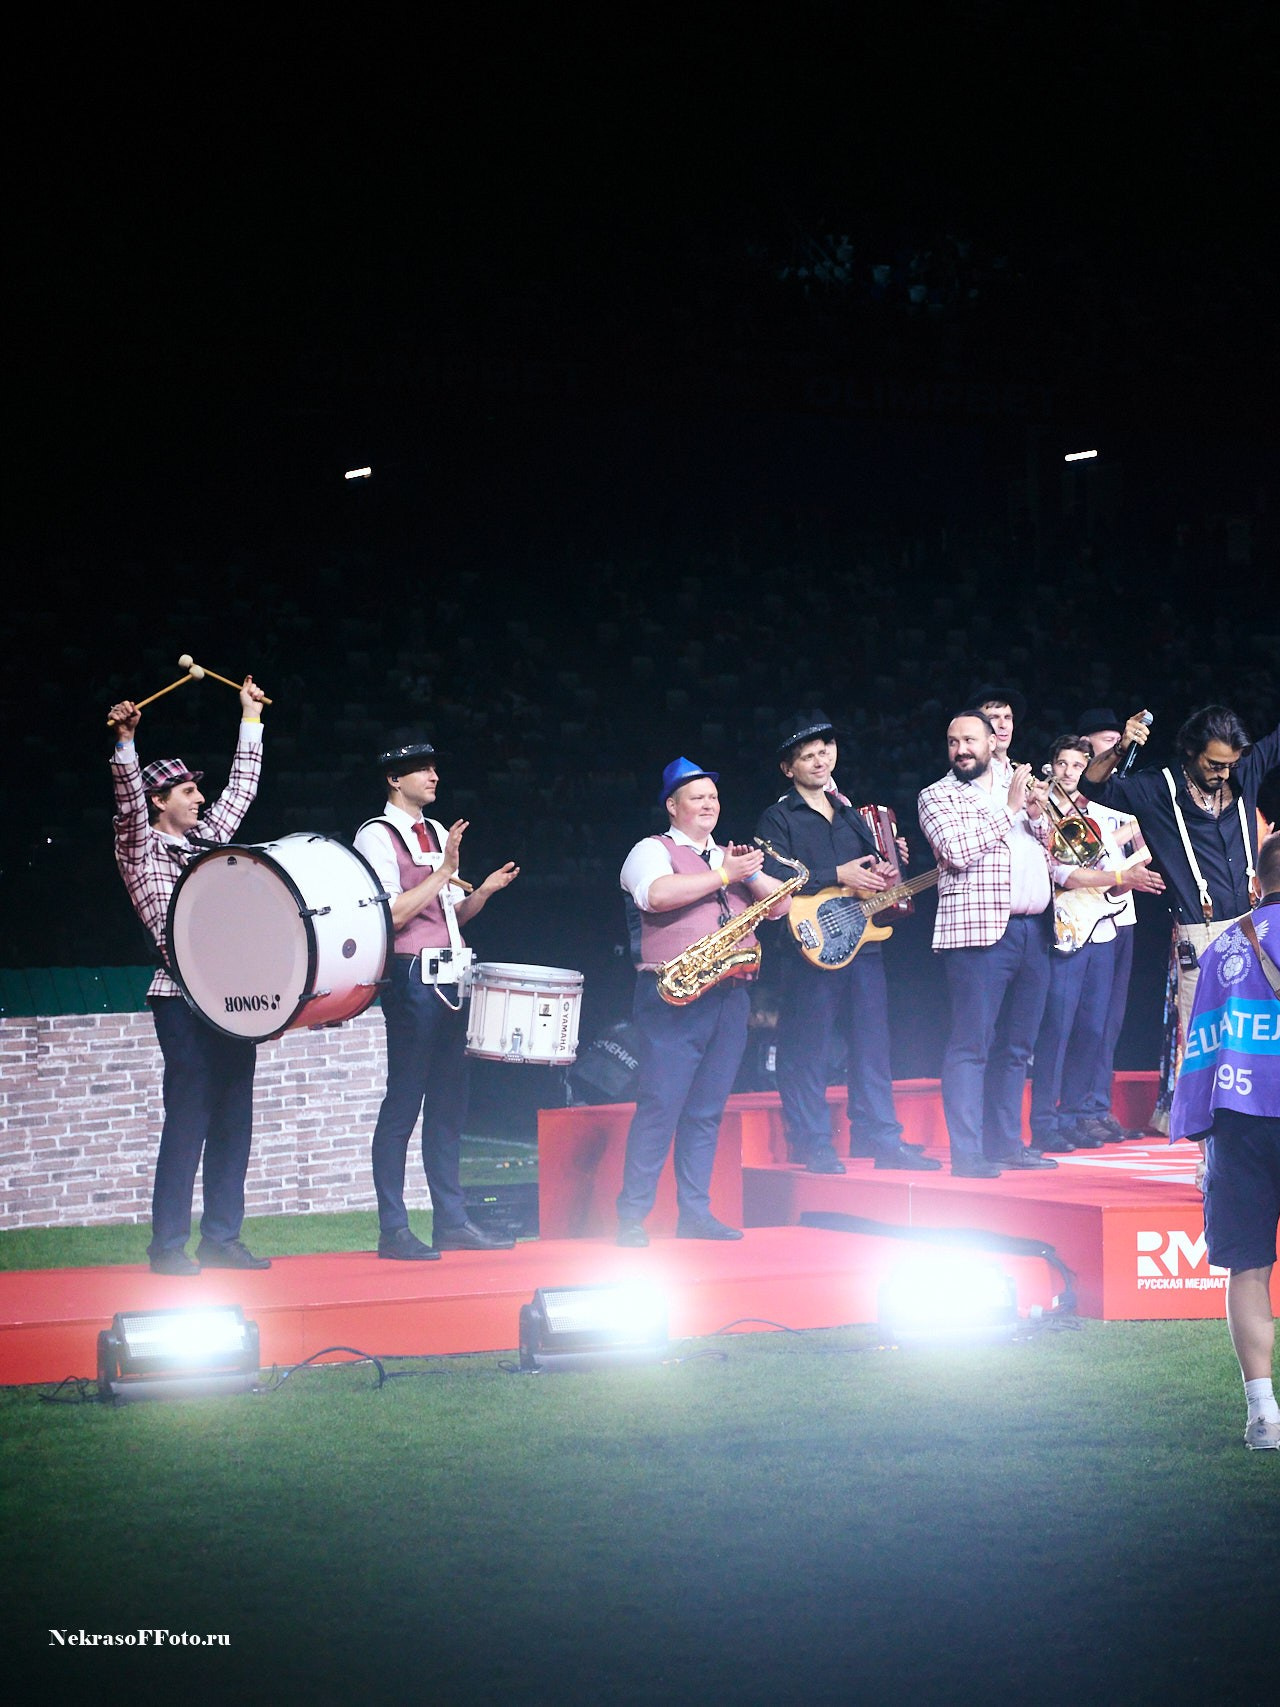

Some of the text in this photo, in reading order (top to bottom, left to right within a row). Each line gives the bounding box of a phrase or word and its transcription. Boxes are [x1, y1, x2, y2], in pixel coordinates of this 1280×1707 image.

[224, 994, 269, 1013] SONOR
[559, 1013, 569, 1051] YAMAHA
[1213, 1063, 1253, 1096] 95
[1137, 1231, 1229, 1276] RM
[1137, 1277, 1229, 1290] РУССКАЯ МЕДИАГ
